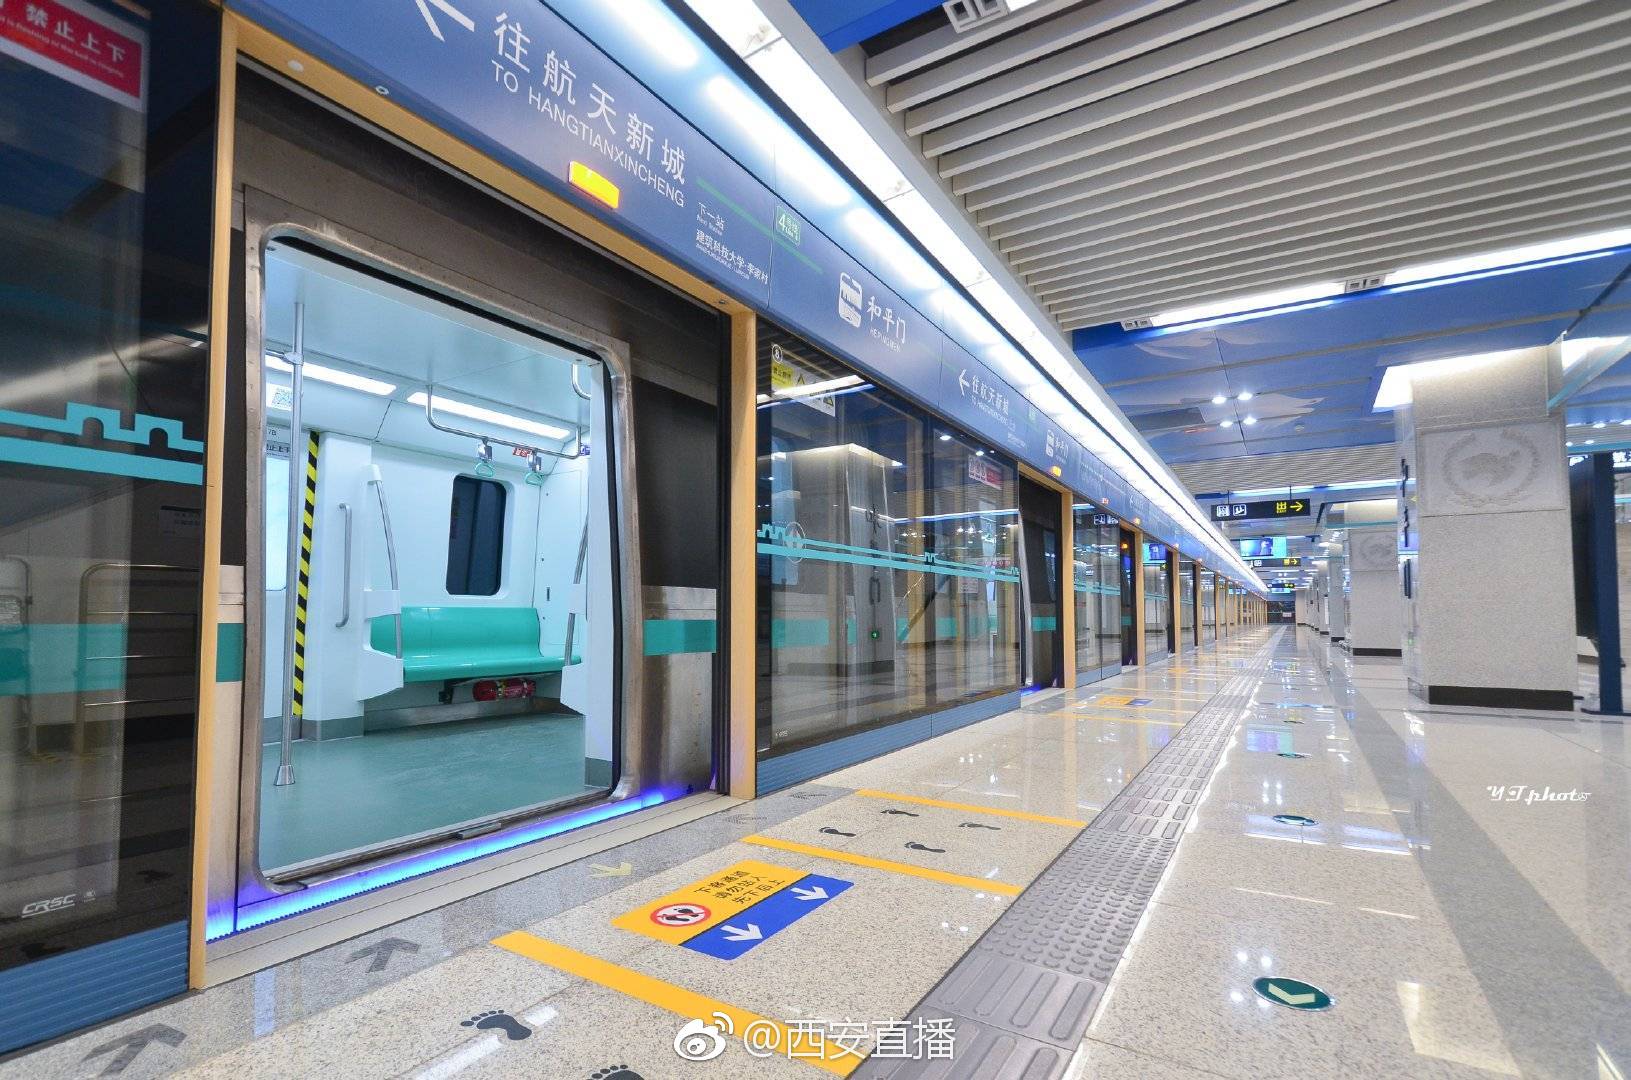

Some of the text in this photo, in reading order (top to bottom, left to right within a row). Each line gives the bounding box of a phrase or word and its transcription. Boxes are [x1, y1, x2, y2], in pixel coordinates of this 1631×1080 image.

[26, 3, 126, 62] 禁止上下
[494, 12, 685, 184] 往航天新城
[491, 59, 685, 208] TO HANGTIANXINCHENG
[866, 295, 906, 344] 和平门
[21, 893, 77, 915] CRSC
